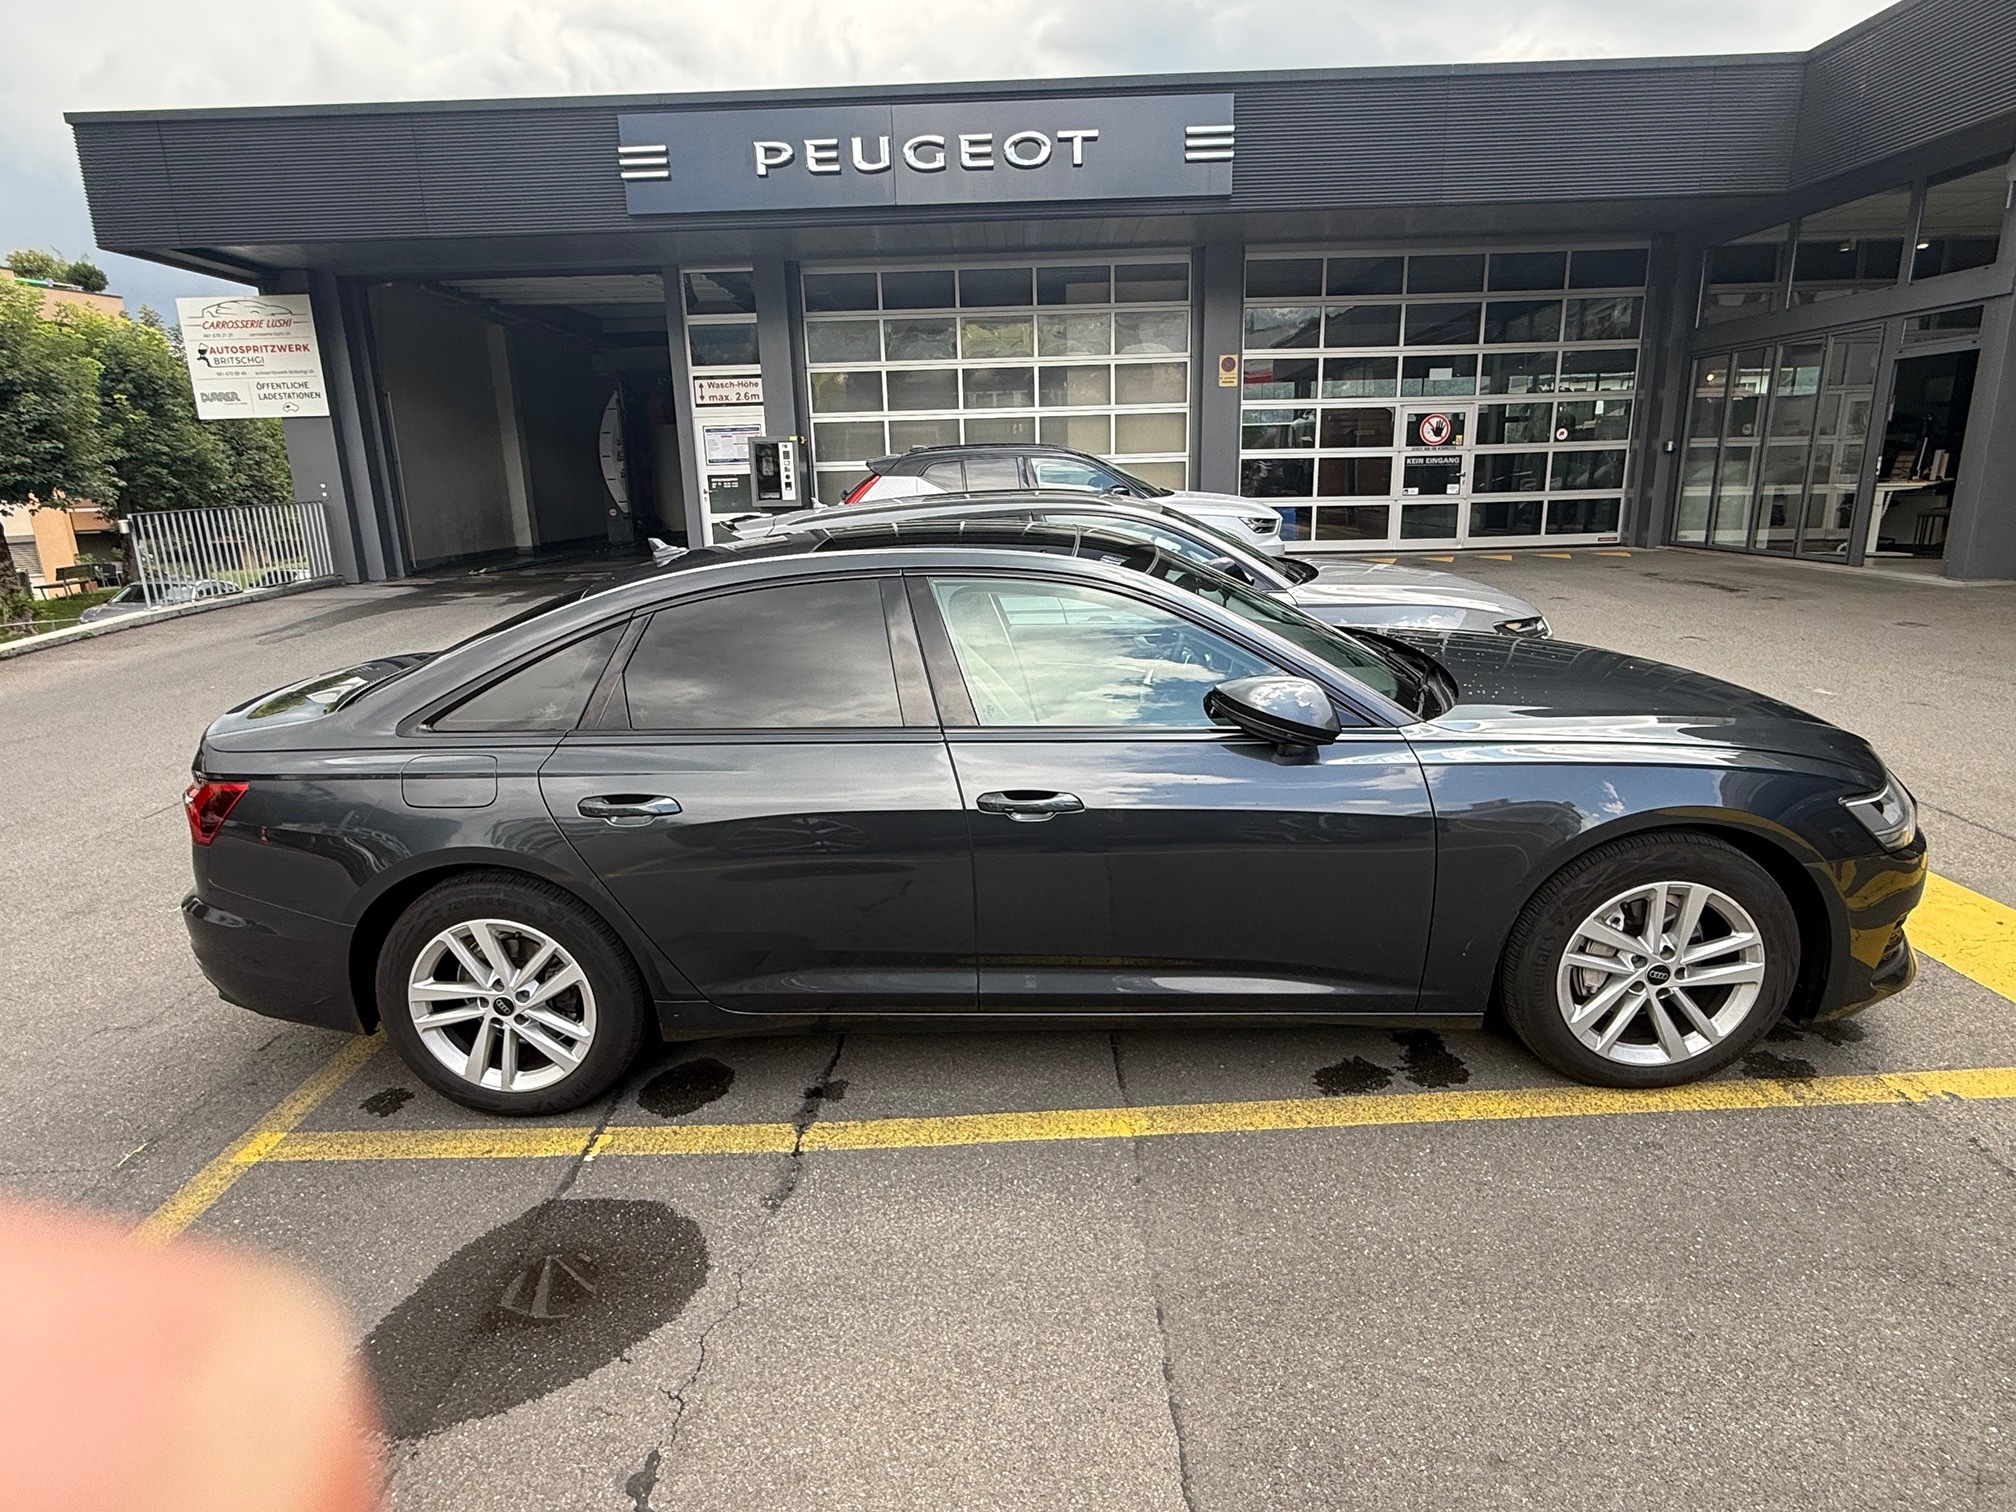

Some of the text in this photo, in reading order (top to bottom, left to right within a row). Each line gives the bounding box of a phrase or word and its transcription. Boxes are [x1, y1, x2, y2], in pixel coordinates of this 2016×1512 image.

[753, 129, 1099, 177] PEUGEOT
[202, 318, 293, 330] CARROSSERIE LUSHI
[209, 343, 311, 355] AUTOSPRITZWERK
[213, 356, 265, 366] BRITSCHGI
[256, 381, 309, 391] ÖFFENTLICHE
[707, 380, 759, 390] Wasch-Höhe
[257, 391, 321, 401] LADESTATIONEN
[708, 394, 732, 402] max.
